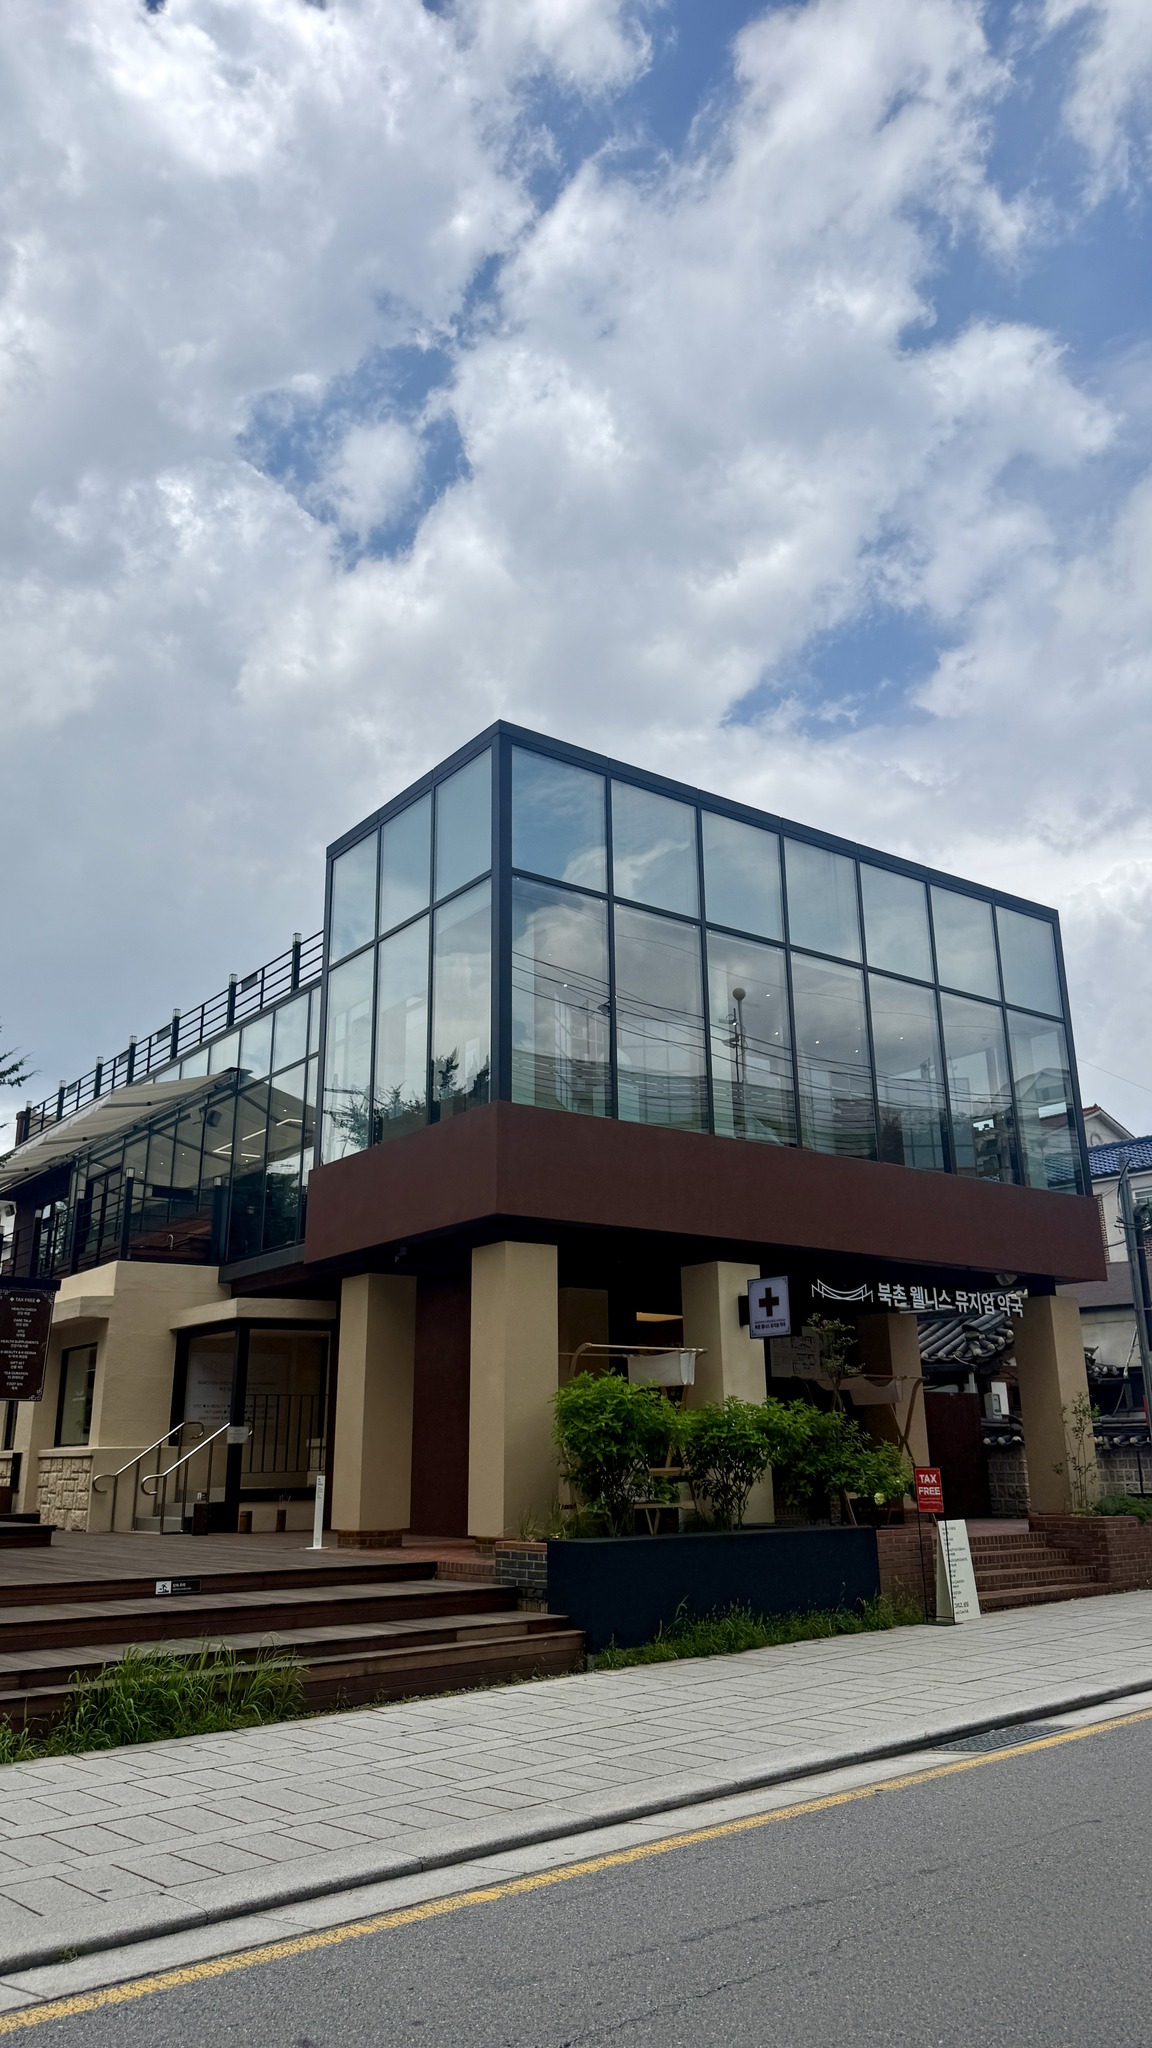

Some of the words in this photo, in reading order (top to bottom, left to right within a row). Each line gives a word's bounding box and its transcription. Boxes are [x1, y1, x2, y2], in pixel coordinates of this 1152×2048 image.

[877, 1282, 908, 1307] 북촌
[910, 1285, 953, 1310] 웰니스
[955, 1290, 995, 1315] 뮤지엄
[997, 1293, 1024, 1318] 약국
[919, 1474, 937, 1484] TAX
[918, 1486, 941, 1496] FREE
